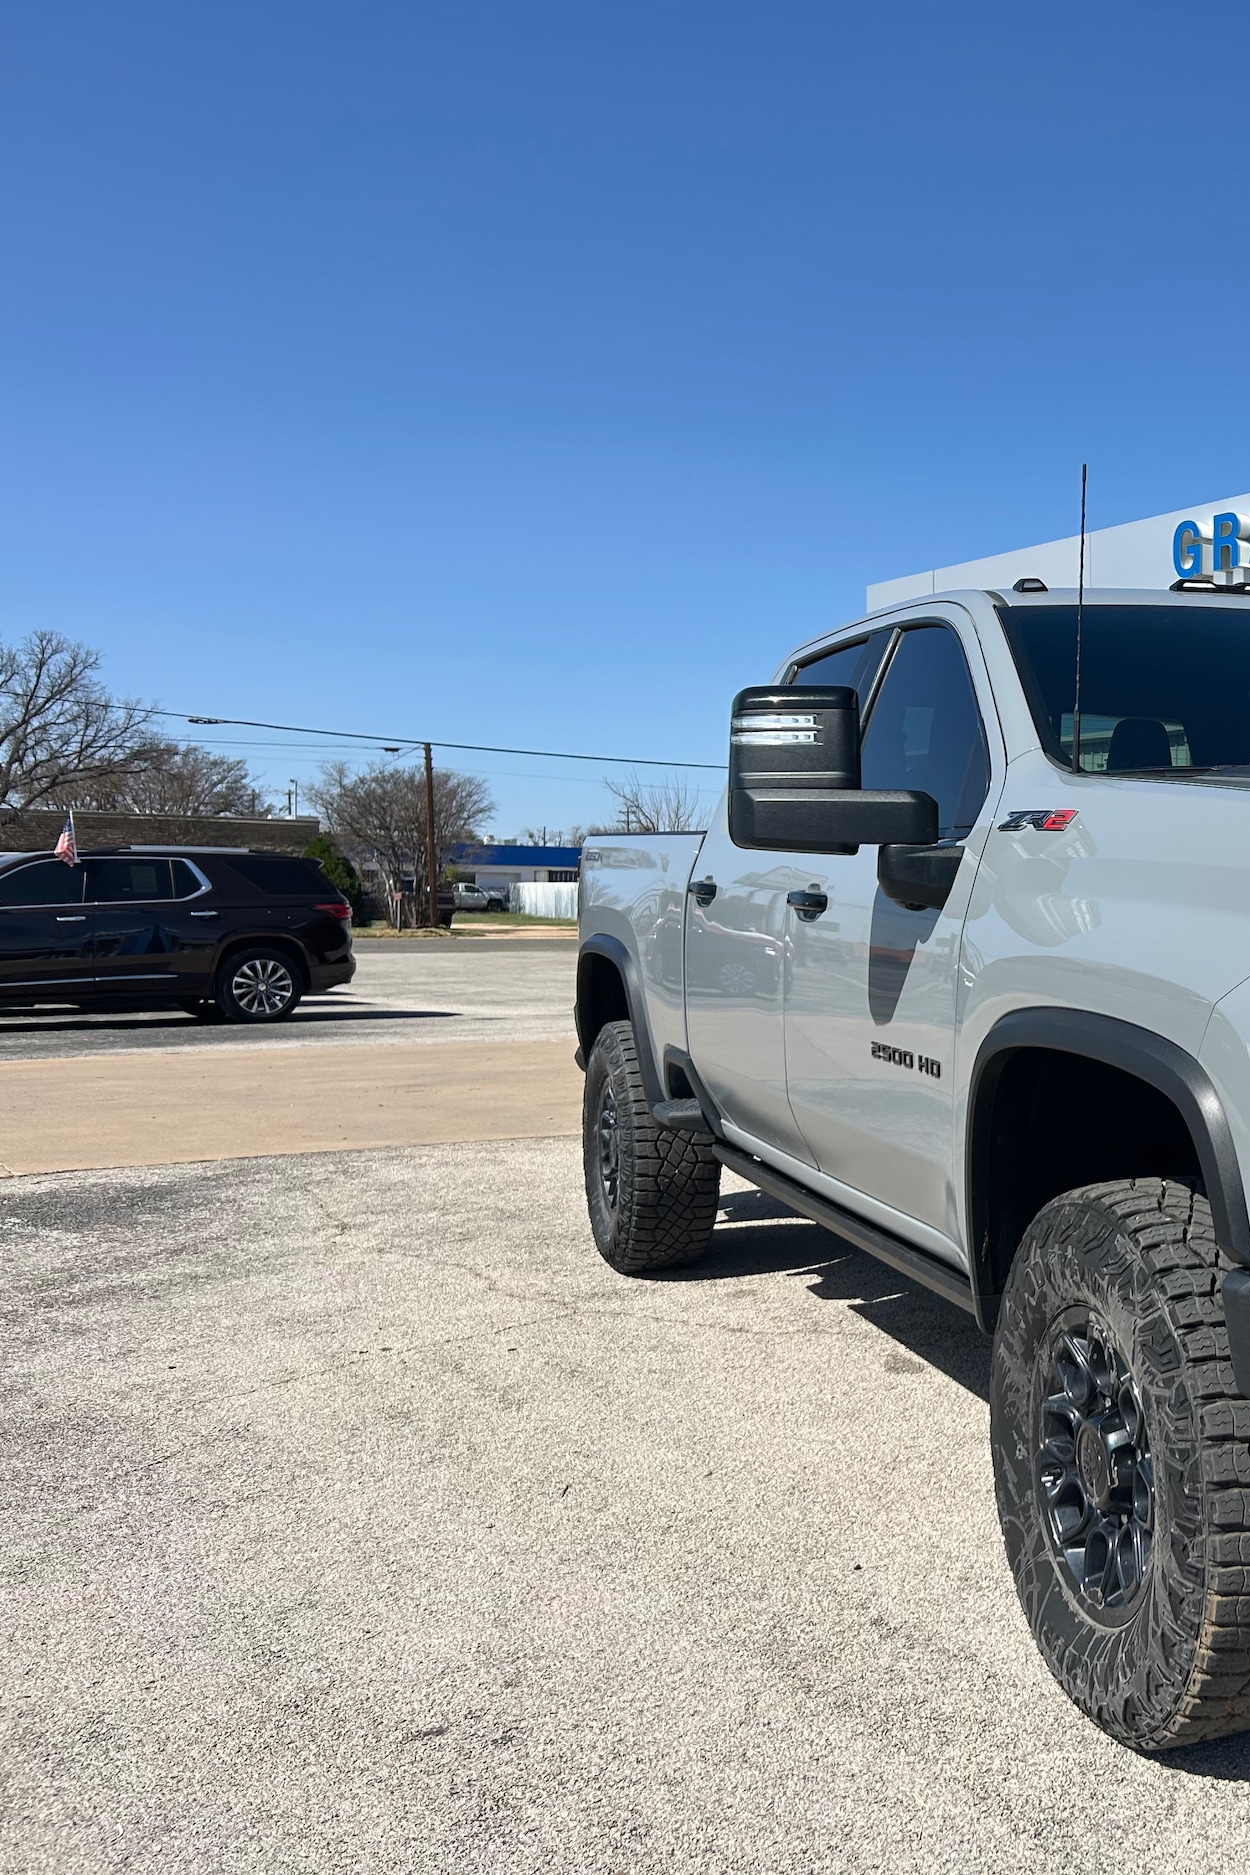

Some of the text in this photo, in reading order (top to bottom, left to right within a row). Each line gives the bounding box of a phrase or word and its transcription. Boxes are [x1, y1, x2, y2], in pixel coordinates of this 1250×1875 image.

[997, 808, 1079, 832] ZR2
[871, 1041, 941, 1080] 2500 HD
